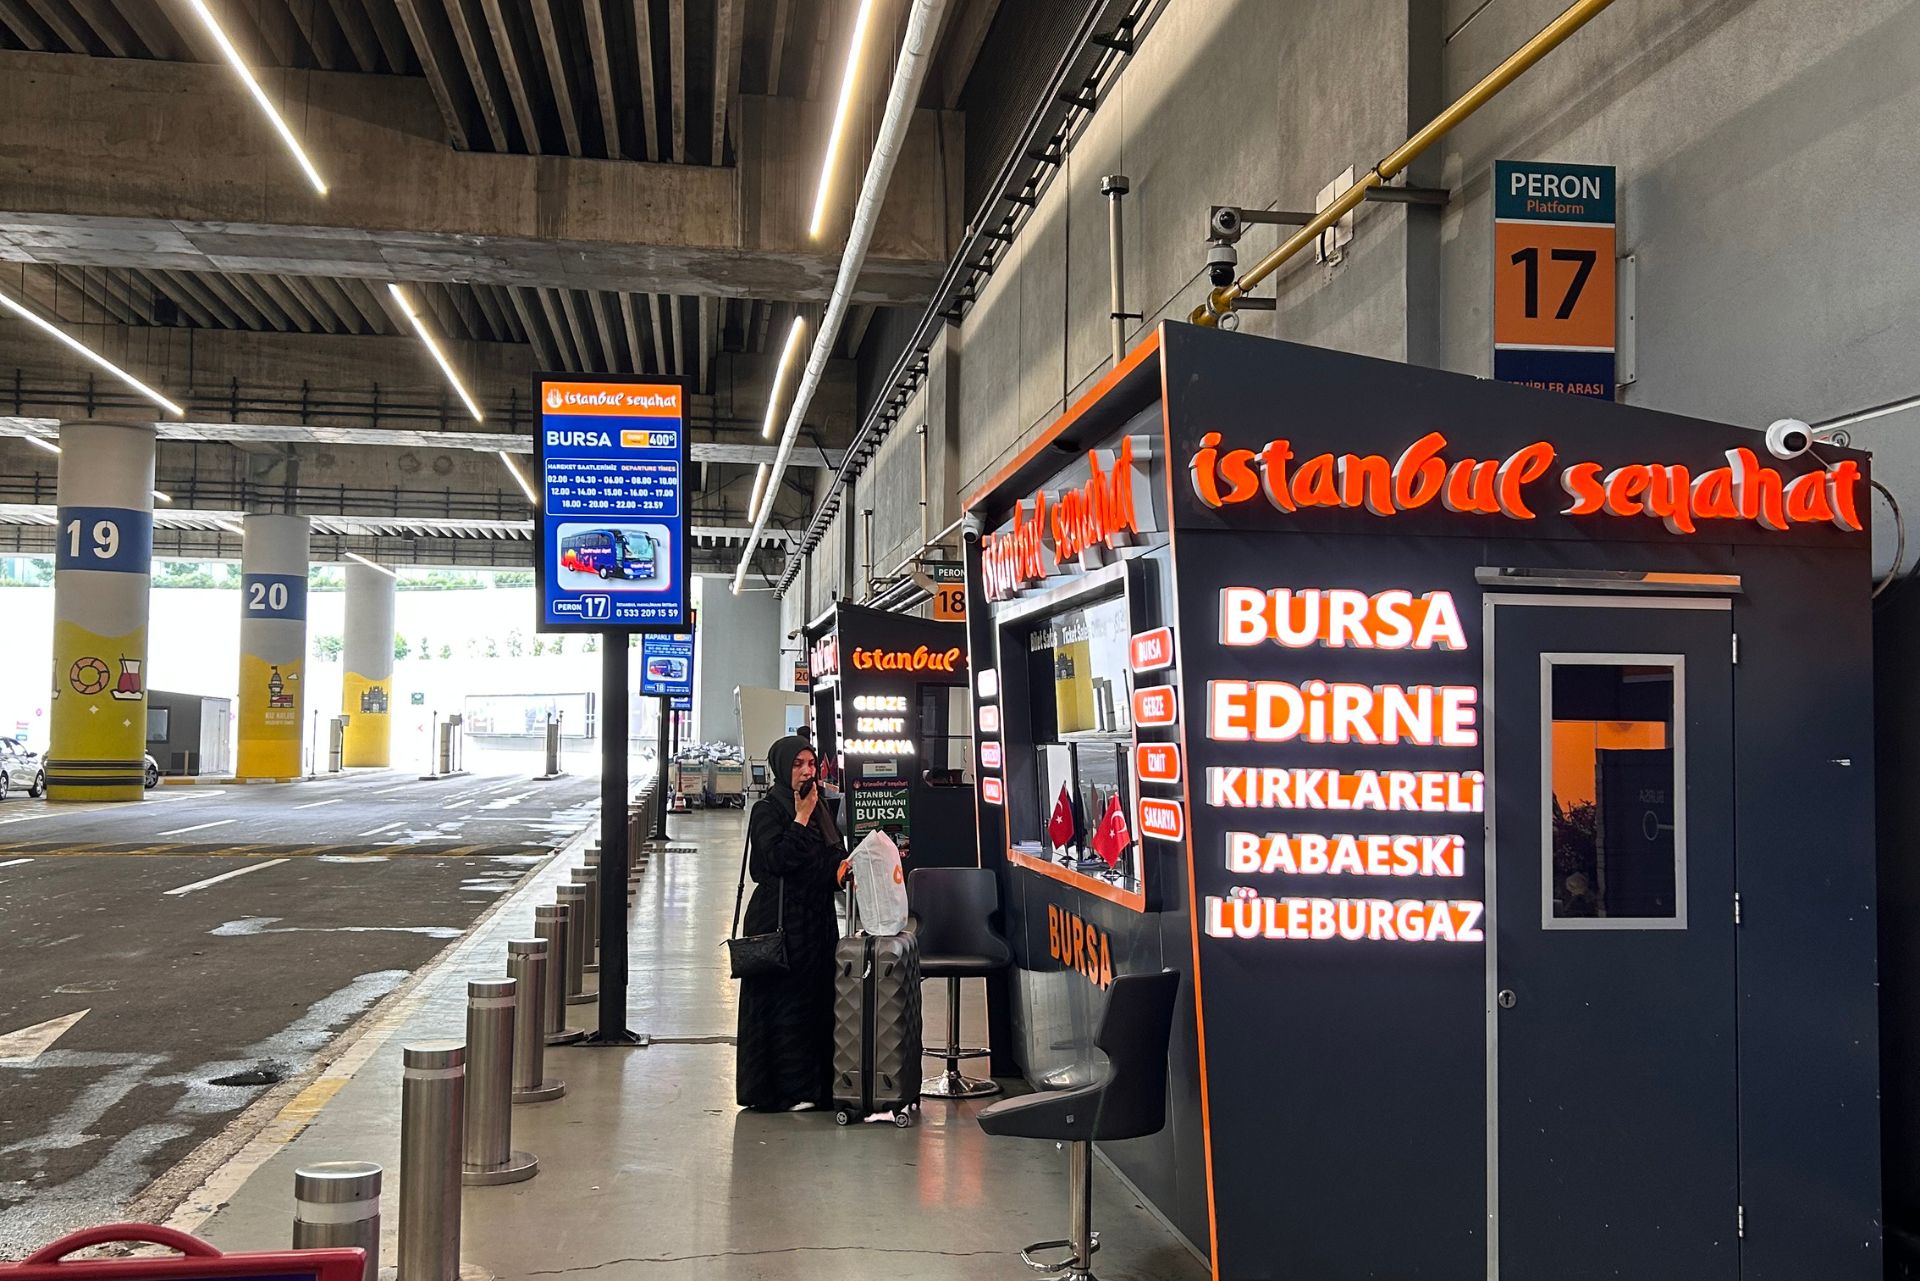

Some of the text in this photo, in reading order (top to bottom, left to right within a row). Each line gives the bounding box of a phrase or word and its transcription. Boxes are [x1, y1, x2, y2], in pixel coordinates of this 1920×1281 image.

[1511, 172, 1600, 199] PERON
[1527, 200, 1584, 214] Platform
[1510, 247, 1597, 320] 17
[565, 391, 676, 408] istanbul seyahat
[1567, 383, 1604, 395] ARASI
[546, 431, 612, 447] BURSA
[1189, 431, 1863, 535] istanbul seyahat
[66, 519, 120, 559] 19
[249, 582, 288, 610] 20
[557, 603, 582, 611] PERON
[585, 598, 606, 617] 17
[938, 590, 966, 613] 18
[624, 609, 639, 617] 533
[1219, 587, 1468, 650] BURSA
[852, 645, 960, 672] istanbul
[1139, 638, 1161, 663] BURSA
[855, 790, 894, 799] İSTANBUL
[855, 798, 906, 807] HAVALİMANI
[856, 808, 906, 820] BURSA
[1144, 805, 1177, 830] SAKARYA
[1205, 886, 1484, 942] LÜLEBURGAZ
[1048, 903, 1112, 992] BURSA
